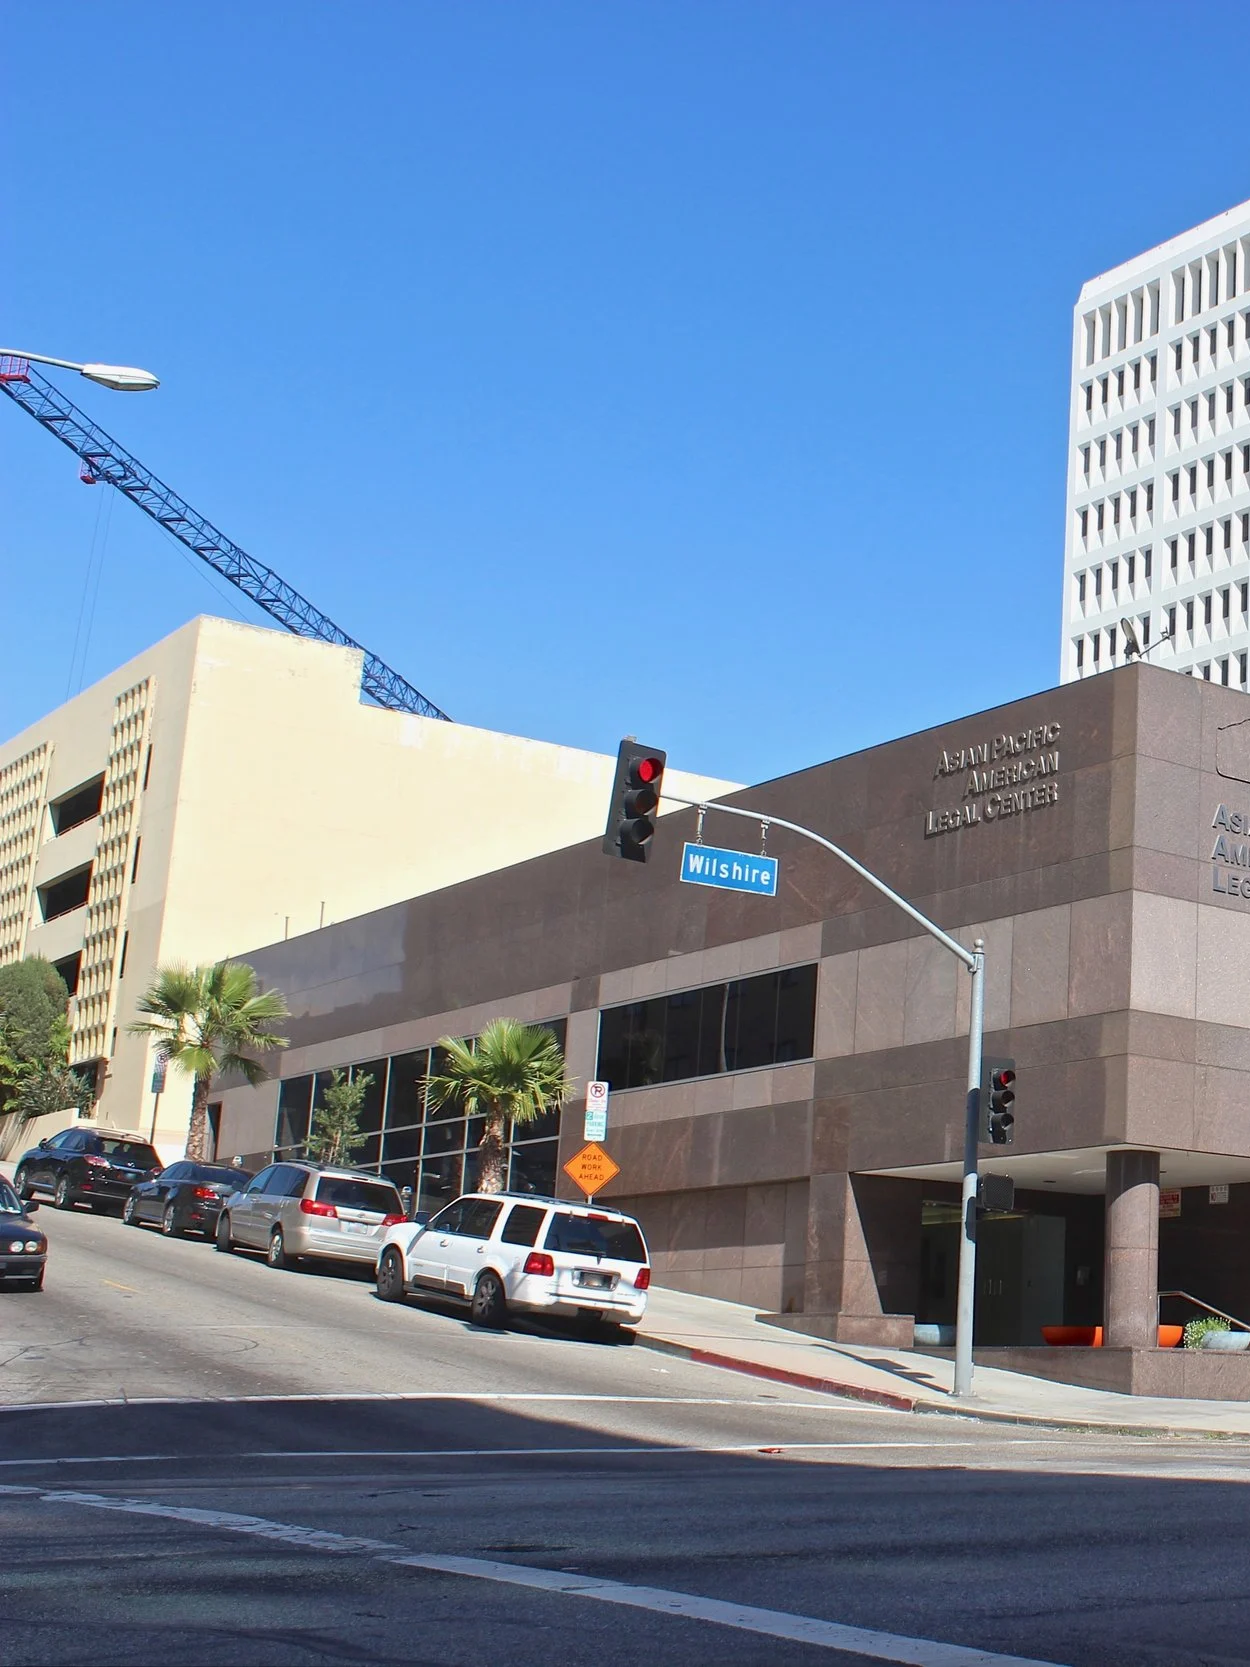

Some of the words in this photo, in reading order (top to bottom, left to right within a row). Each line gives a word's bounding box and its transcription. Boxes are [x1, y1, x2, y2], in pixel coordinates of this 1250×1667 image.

[934, 743, 987, 777] ASIAN
[991, 721, 1061, 759] PACIFIC
[964, 751, 1059, 796] AMERICAN
[925, 803, 980, 836] LEGAL
[985, 782, 1058, 818] CENTER
[689, 853, 770, 885] Wilshire
